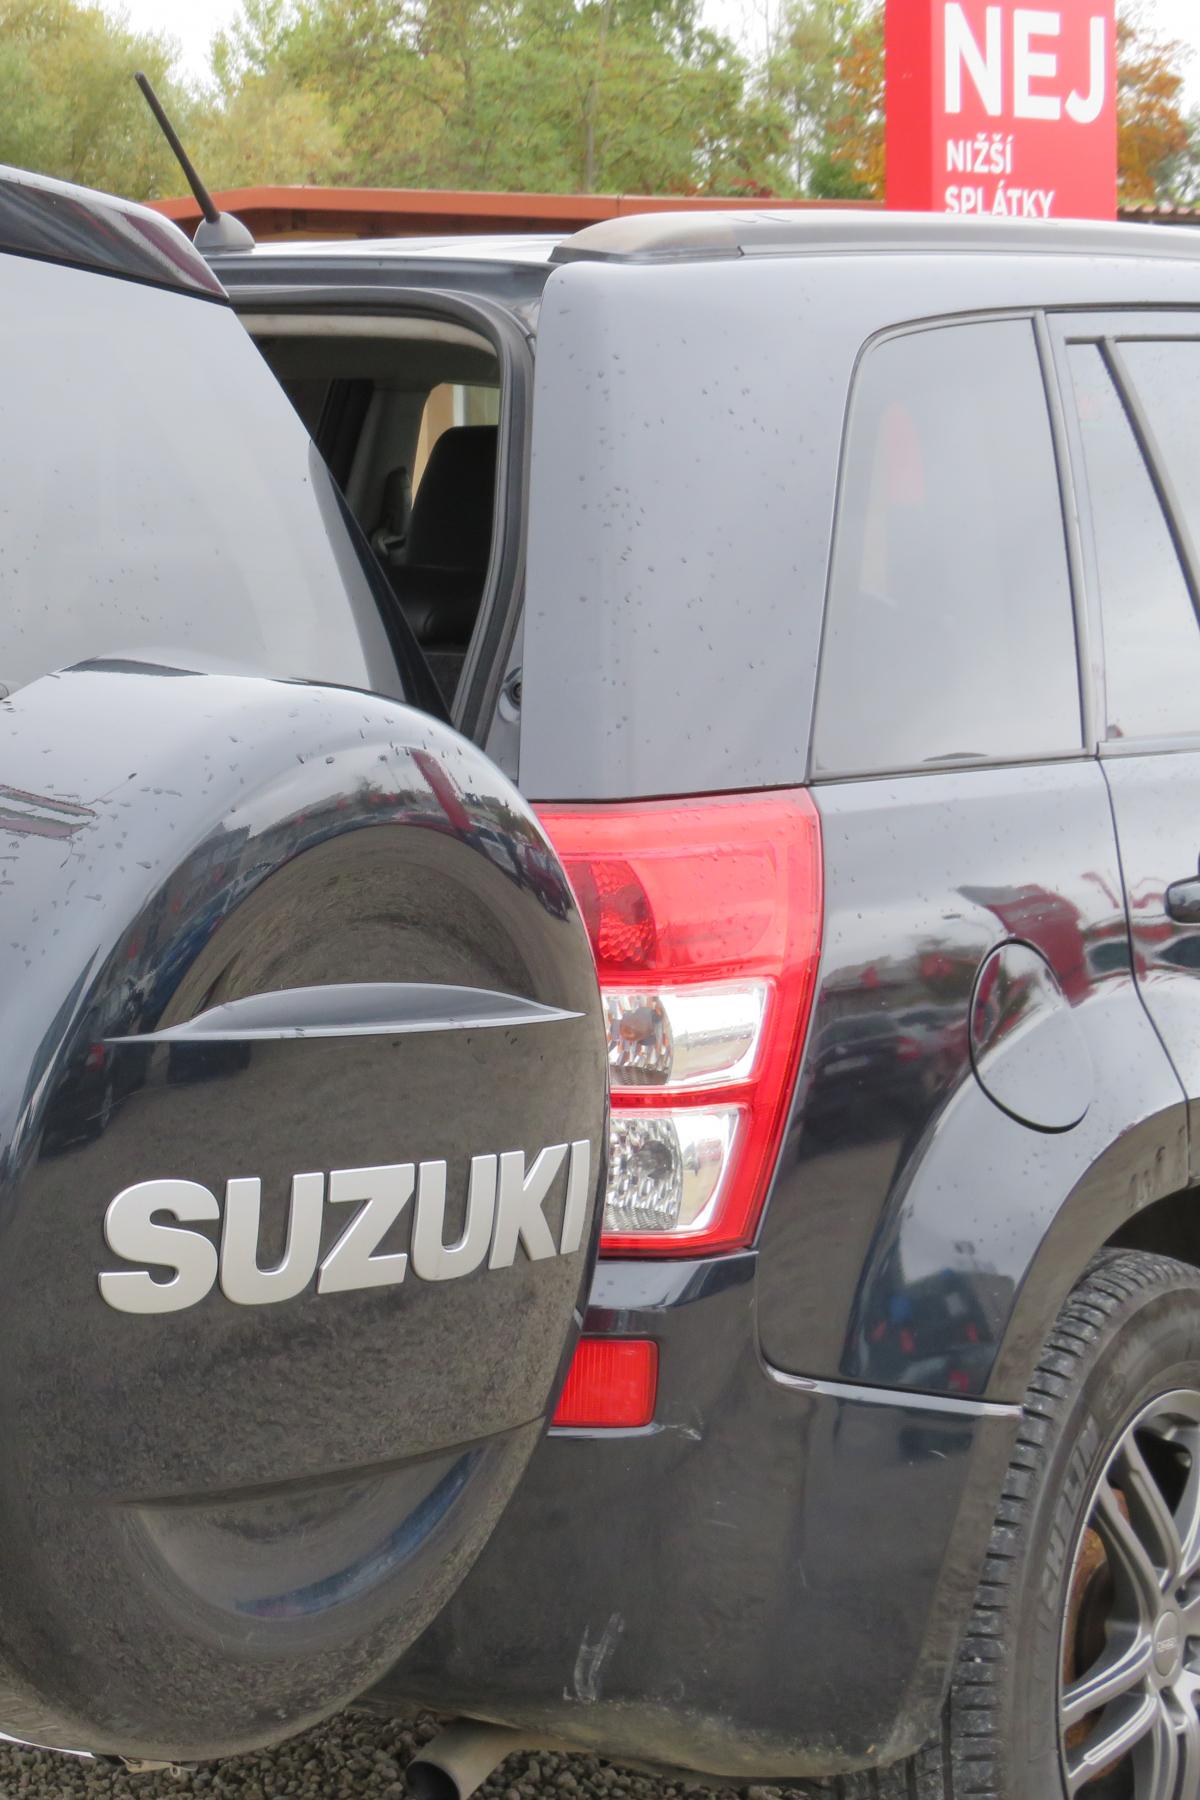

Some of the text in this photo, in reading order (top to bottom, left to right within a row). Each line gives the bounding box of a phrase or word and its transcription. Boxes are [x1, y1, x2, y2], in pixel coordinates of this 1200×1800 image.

[944, 2, 1106, 124] NEJ
[946, 133, 1014, 175] NIŽŠÍ
[945, 180, 1055, 218] SPLÁTKY
[98, 1139, 591, 1315] SUZUKI
